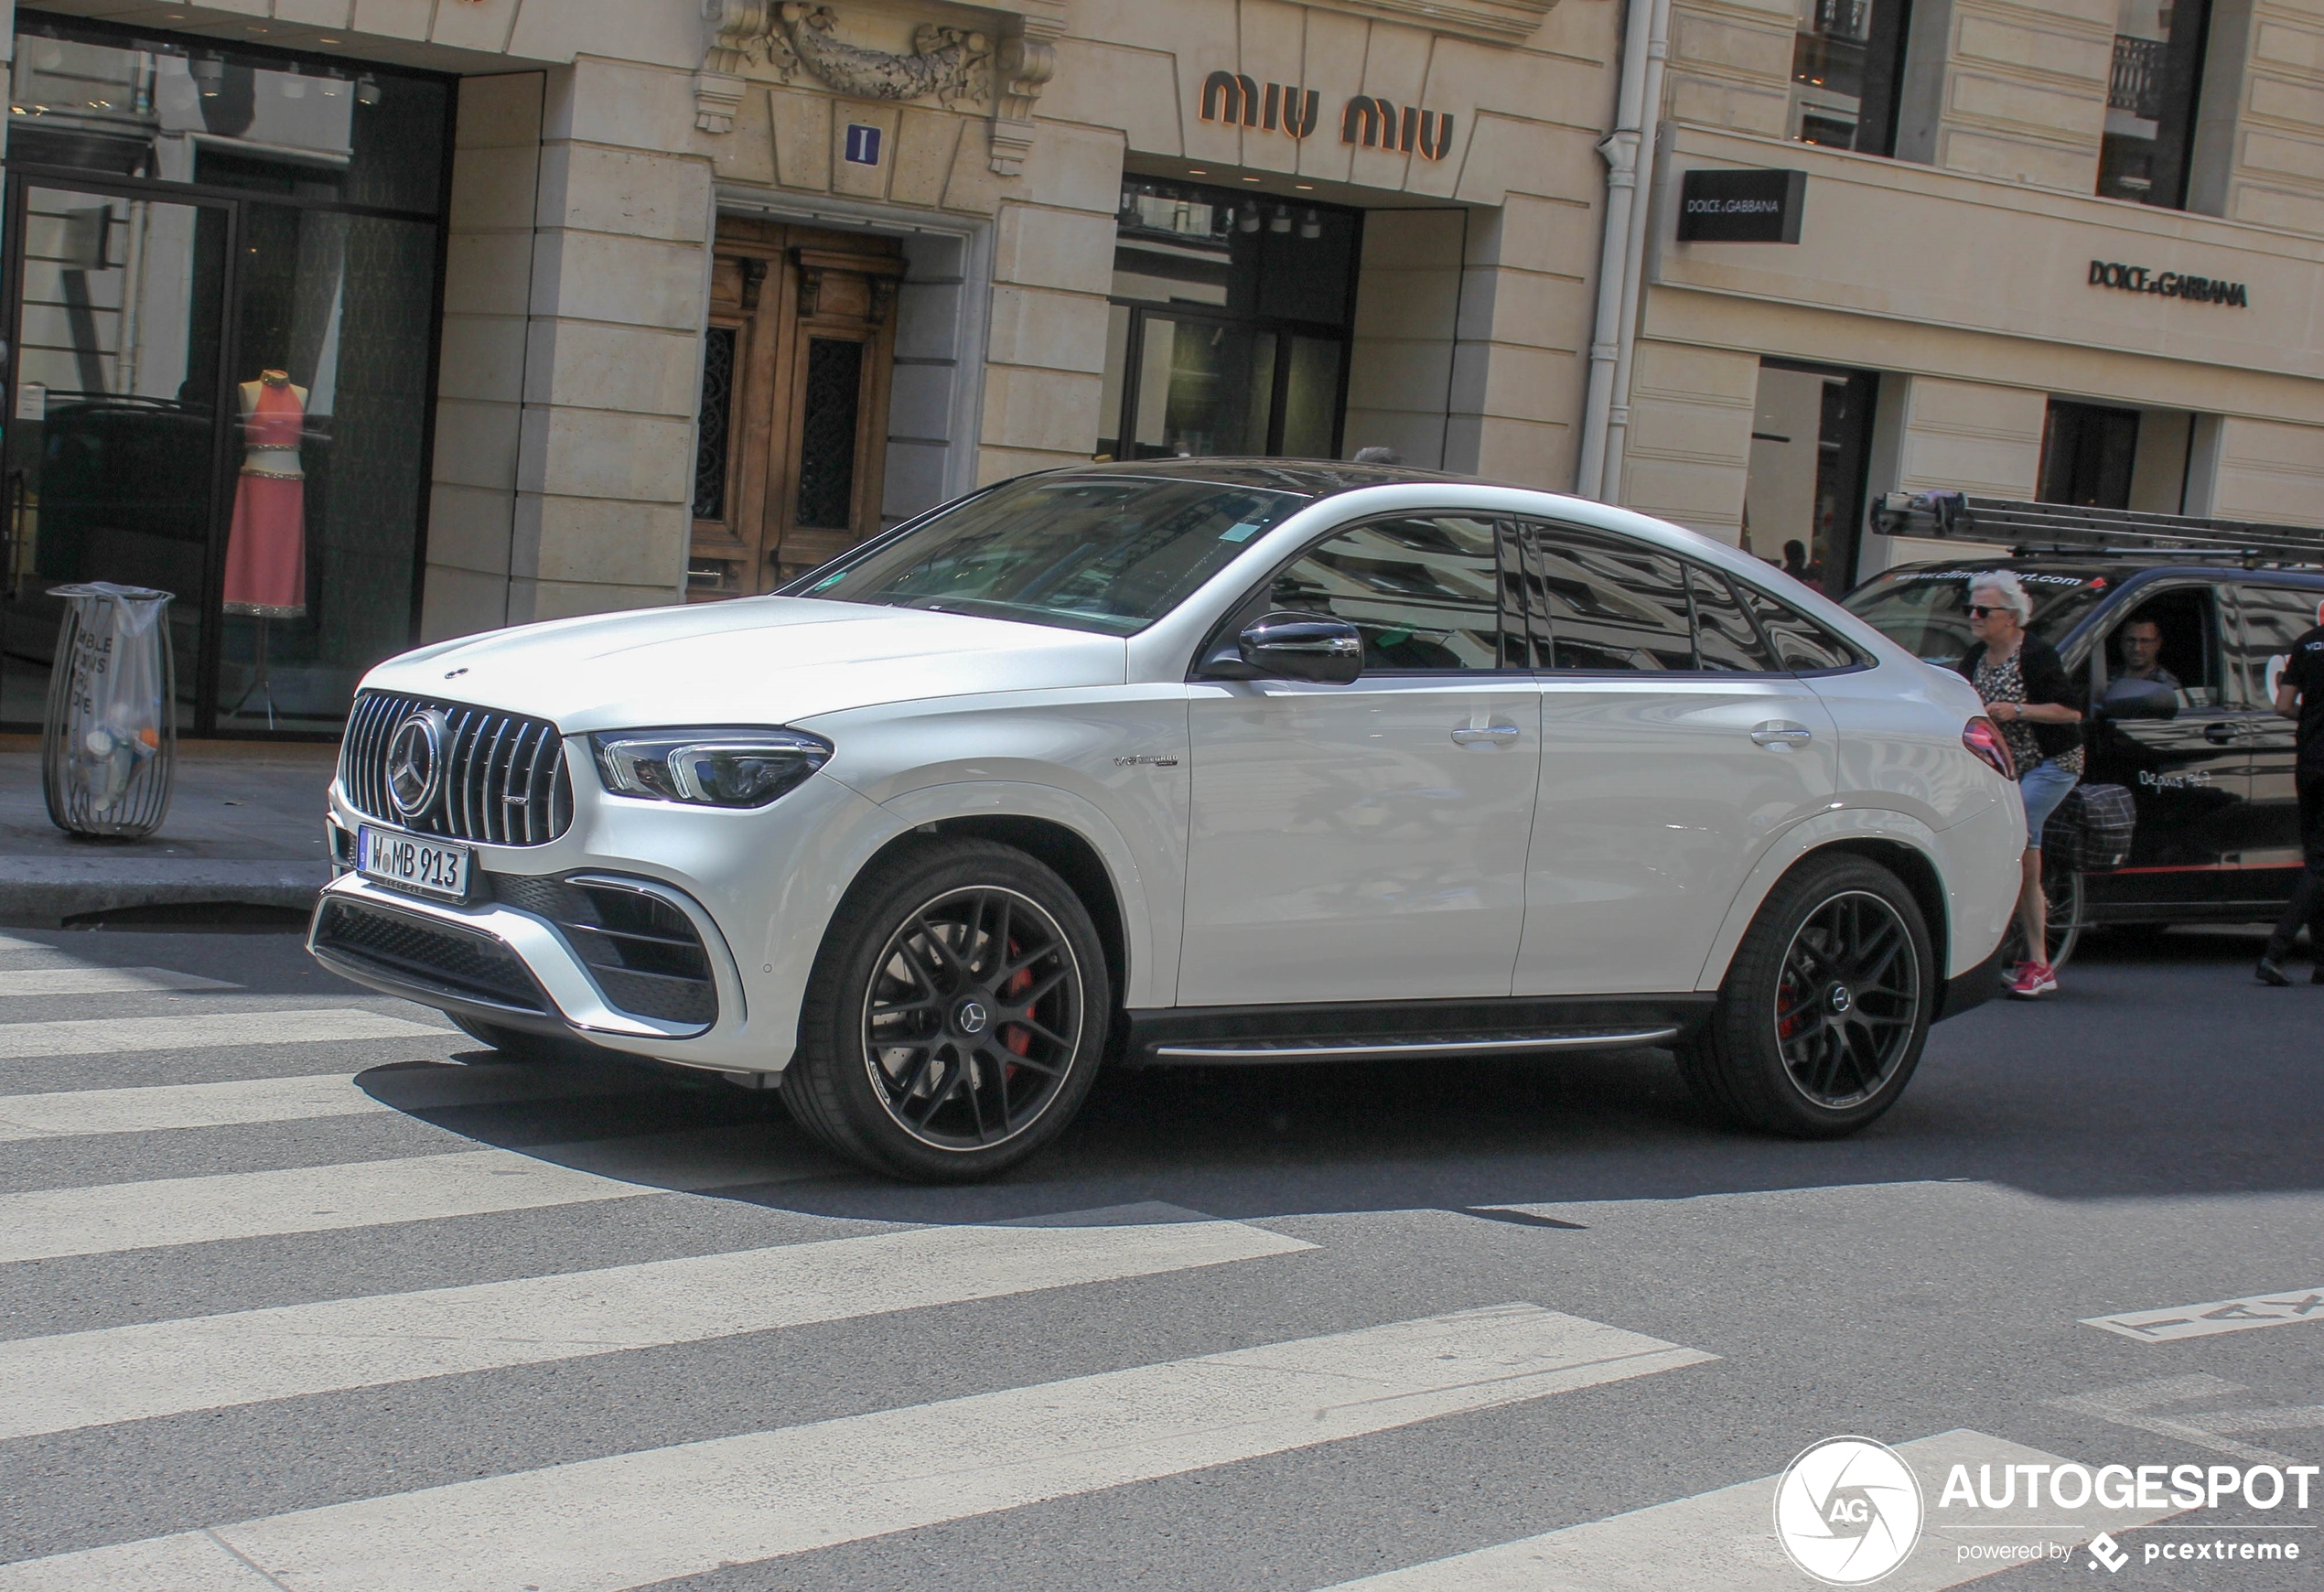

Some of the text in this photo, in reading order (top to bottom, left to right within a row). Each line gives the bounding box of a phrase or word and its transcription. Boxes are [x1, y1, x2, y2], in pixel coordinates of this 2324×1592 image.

[1896, 570, 2082, 586] www.climdrt.com
[2139, 770, 2183, 793] Depuis
[373, 834, 457, 887] W MB 913
